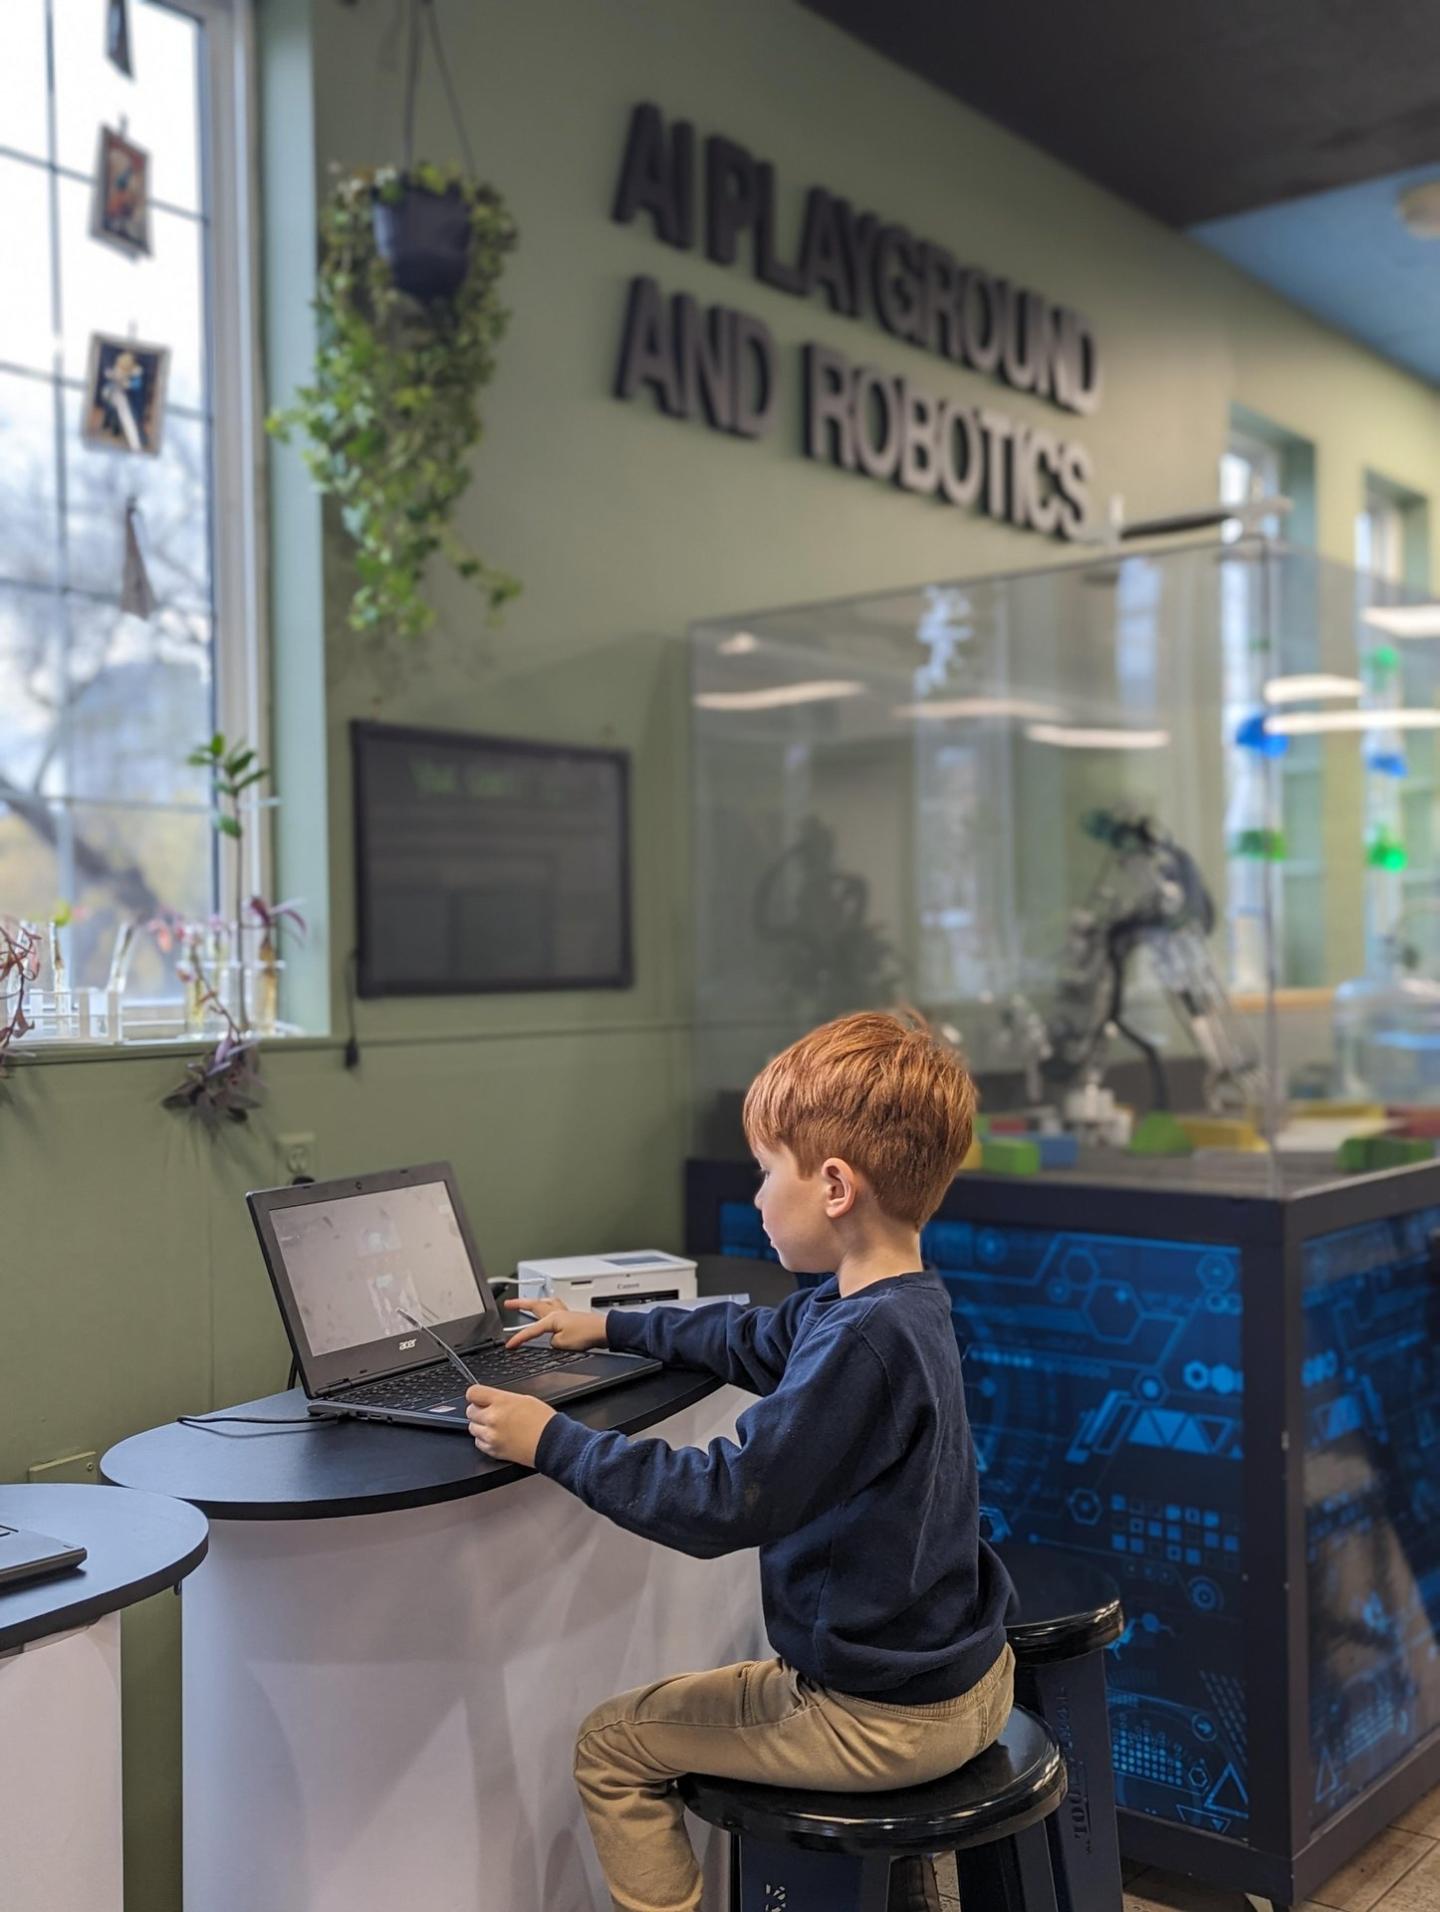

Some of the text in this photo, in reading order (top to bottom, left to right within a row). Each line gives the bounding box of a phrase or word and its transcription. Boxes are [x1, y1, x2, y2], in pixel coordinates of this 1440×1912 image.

[611, 101, 1101, 416] AI PLAYGROUND
[612, 274, 1094, 544] AND ROBOTICS
[399, 1338, 417, 1351] acer
